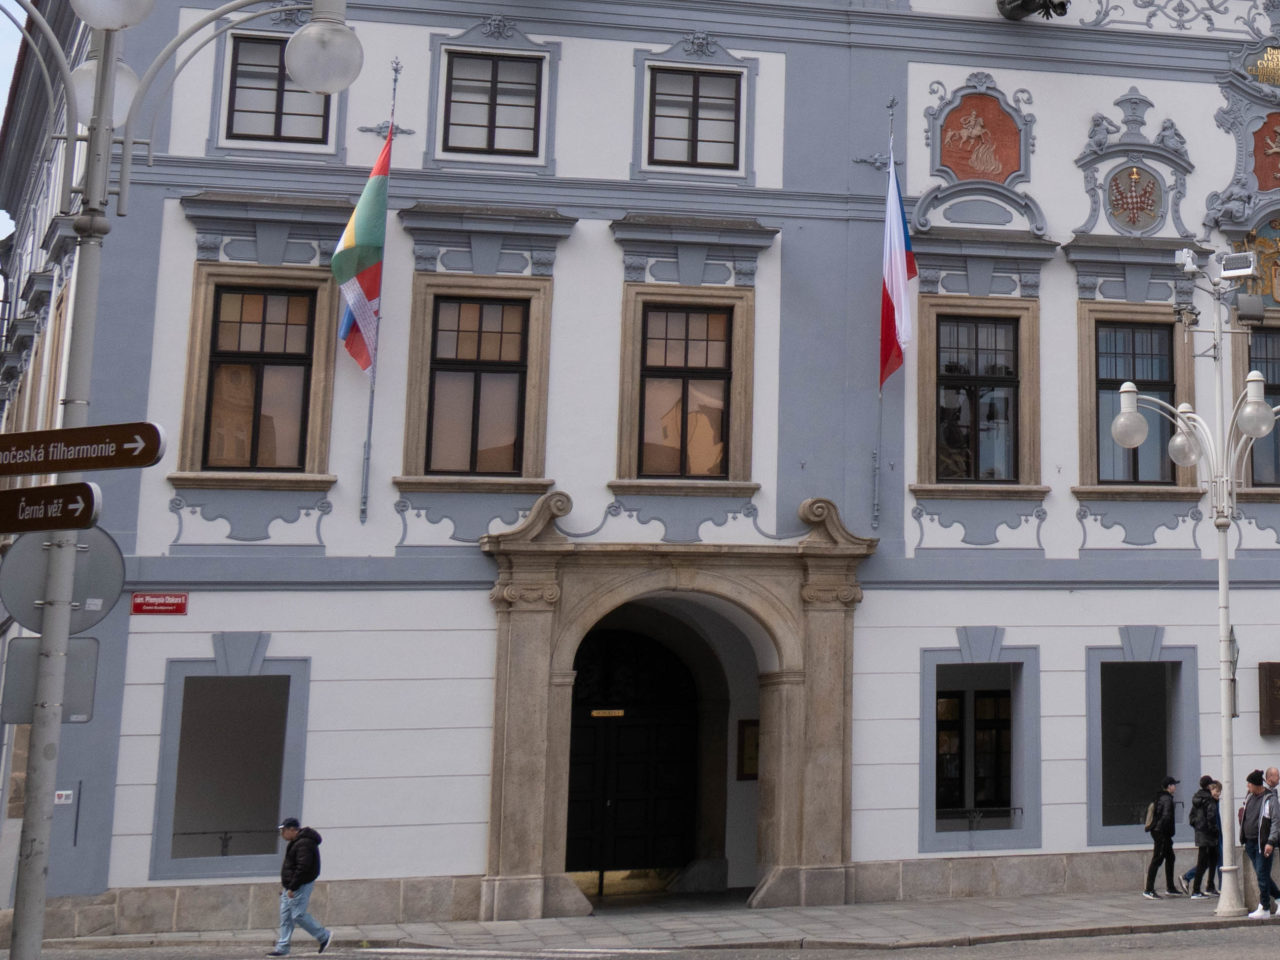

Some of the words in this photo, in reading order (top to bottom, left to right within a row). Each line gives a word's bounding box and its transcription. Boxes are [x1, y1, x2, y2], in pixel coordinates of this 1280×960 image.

[48, 439, 116, 460] filharmonie
[18, 497, 45, 520] Černá
[47, 499, 64, 518] věž
